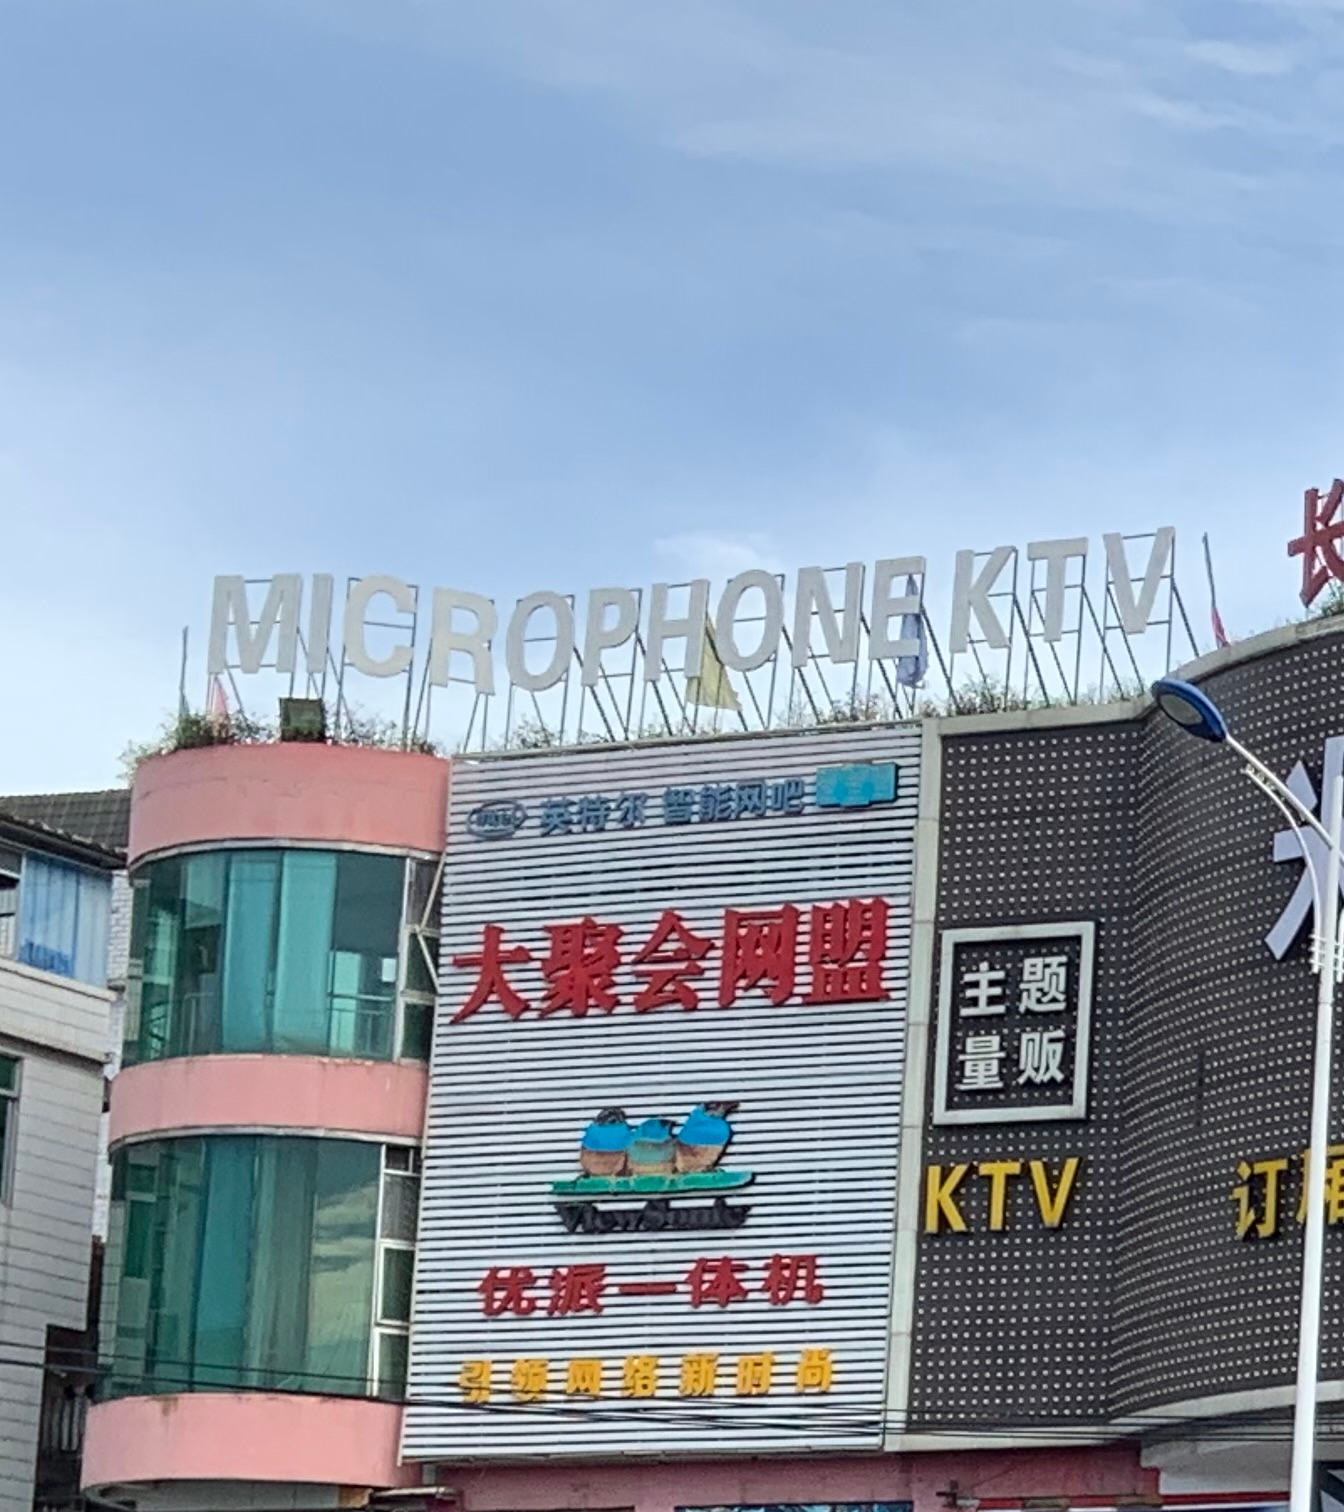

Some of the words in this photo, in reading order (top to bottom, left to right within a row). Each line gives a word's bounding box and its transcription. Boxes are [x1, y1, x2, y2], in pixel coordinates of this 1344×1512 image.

[204, 556, 926, 697] MICROPHONE
[949, 525, 1176, 654] KTV
[451, 896, 892, 1024] 大聚会网盟
[959, 955, 1068, 1017] 主题
[956, 1028, 1066, 1091] 量贩
[924, 1157, 1081, 1234] KTV
[477, 1254, 824, 1317] 优派一体机
[459, 1348, 834, 1403] 引领网络新时尚
